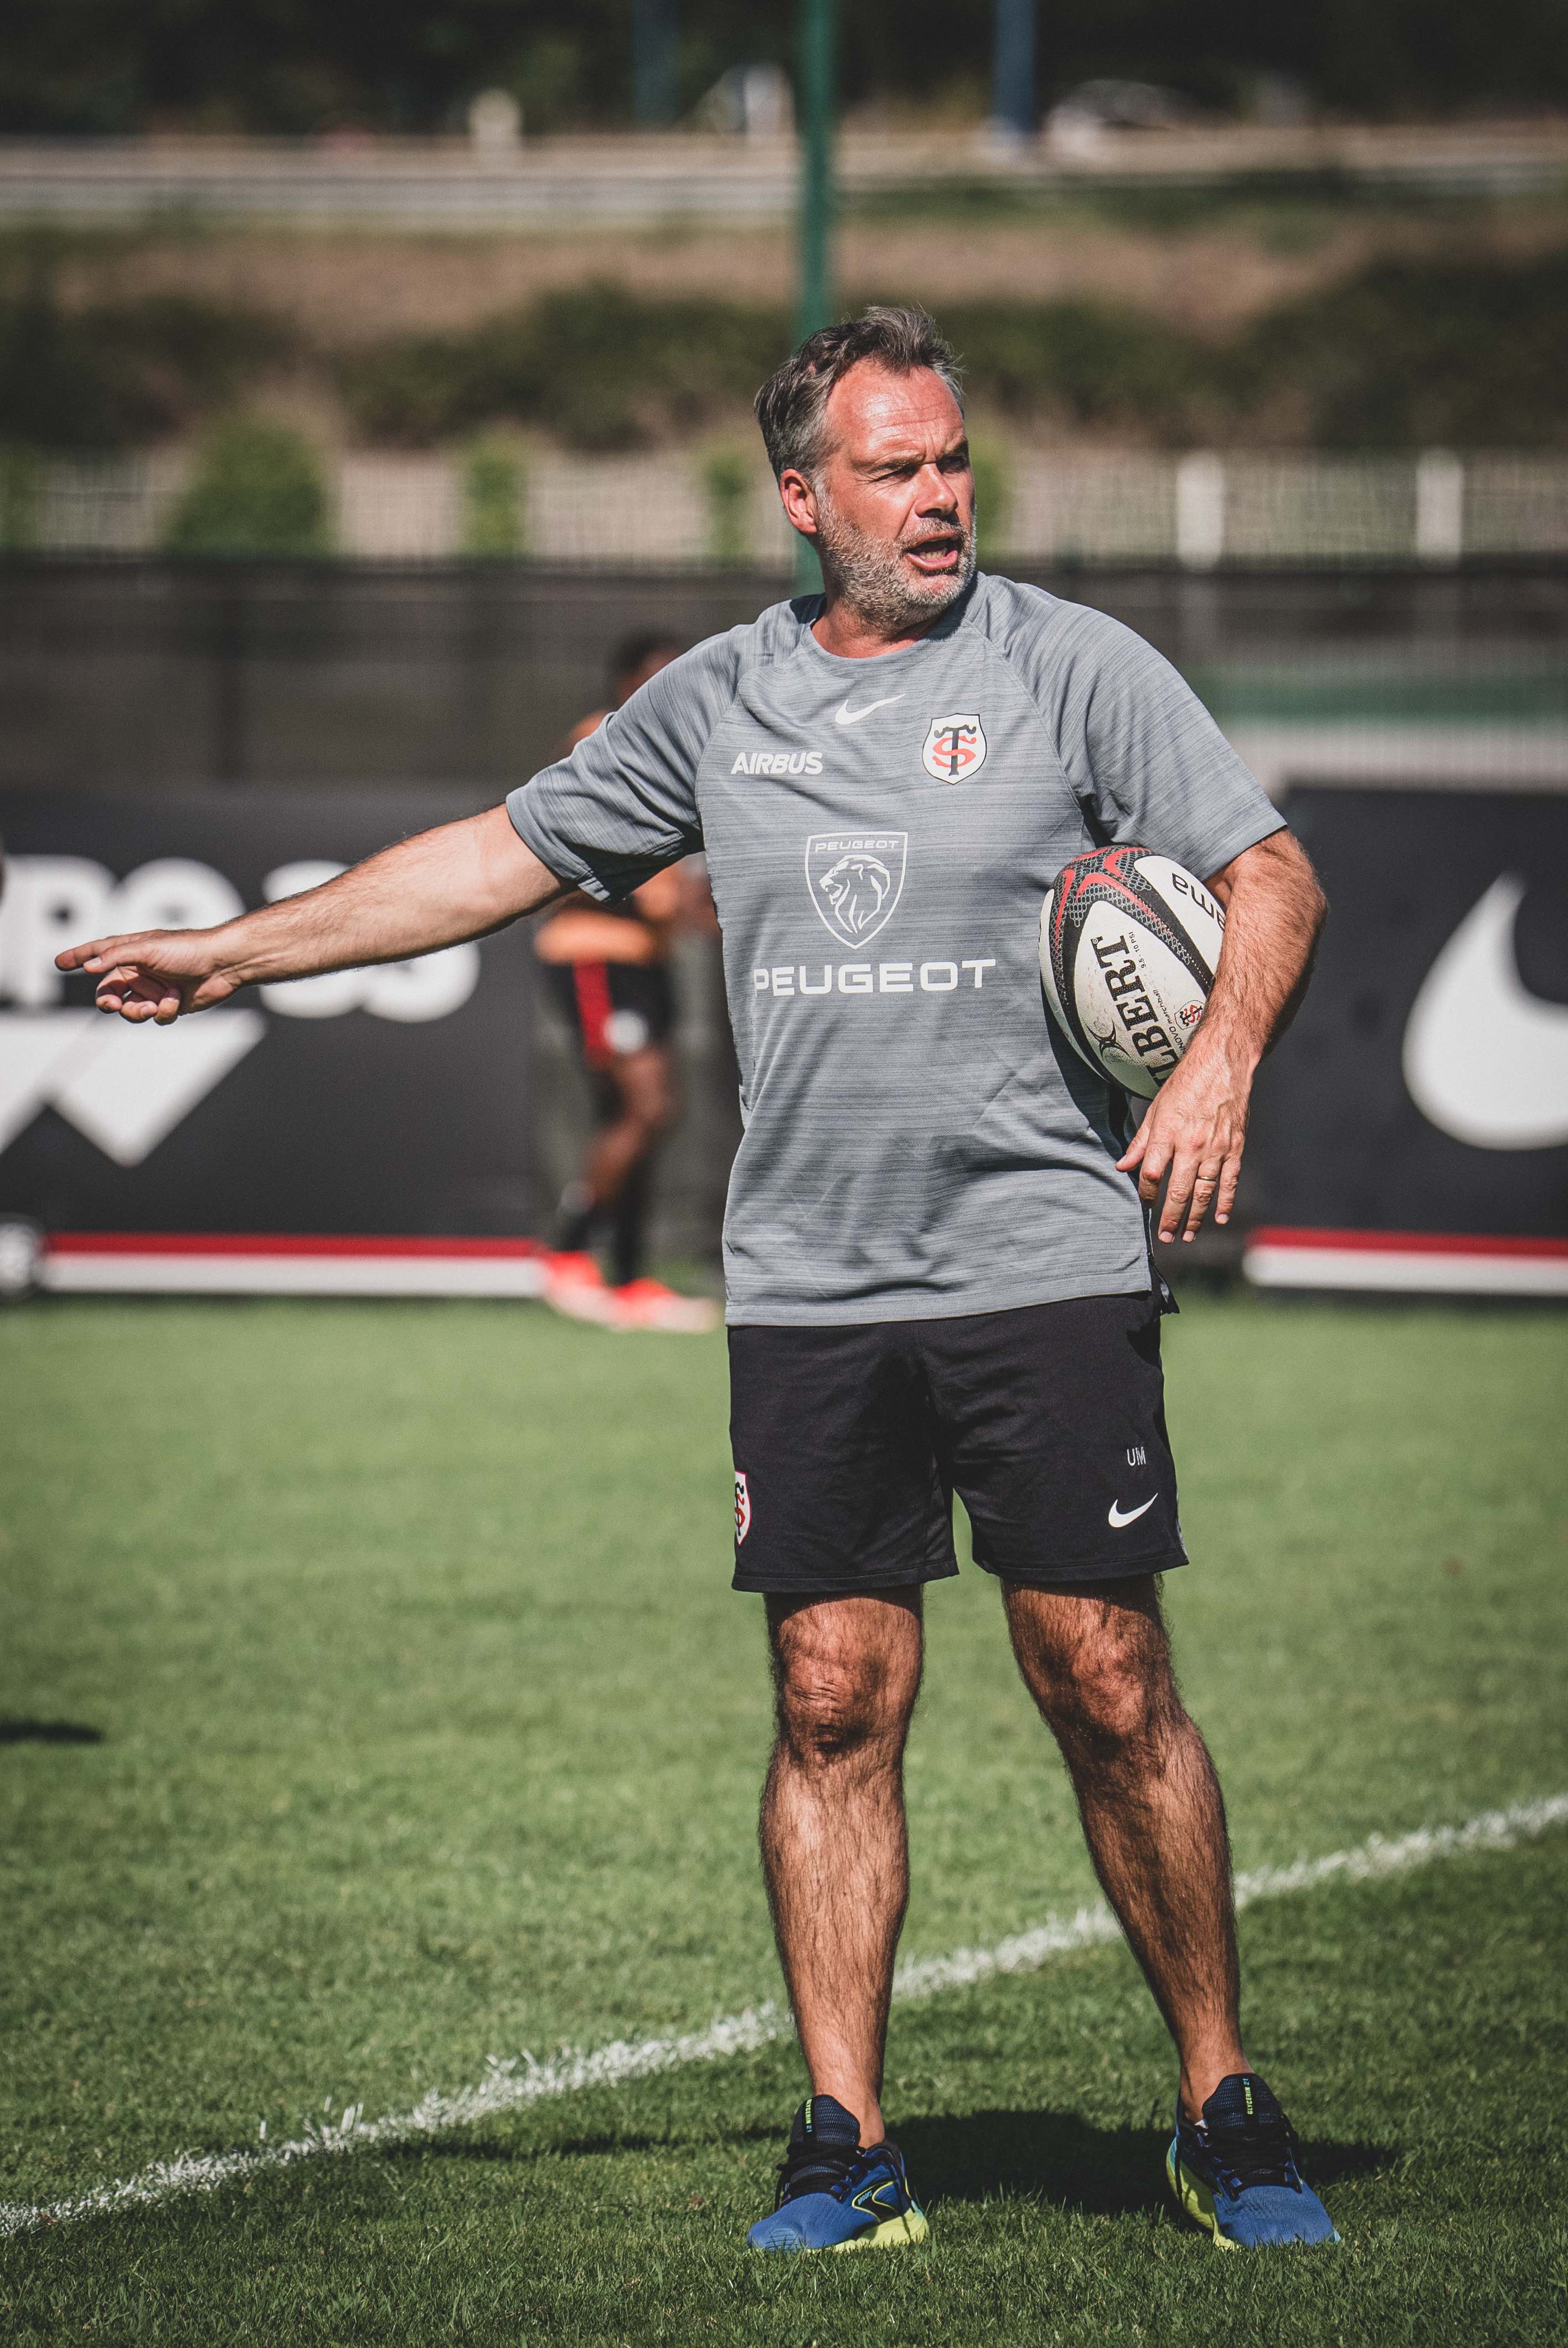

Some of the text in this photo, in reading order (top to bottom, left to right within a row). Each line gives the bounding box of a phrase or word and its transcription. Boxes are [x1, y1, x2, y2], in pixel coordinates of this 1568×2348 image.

[730, 751, 824, 775] AIRBUS
[815, 840, 899, 853] PEUGEOT
[1128, 931, 1137, 944] PSI
[754, 959, 996, 997] PEUGEOT
[1091, 935, 1179, 1088] LBERT
[1152, 989, 1173, 1024] matchball
[1127, 1446, 1146, 1466] UM
[1245, 2087, 1254, 2114] GLYCERIN
